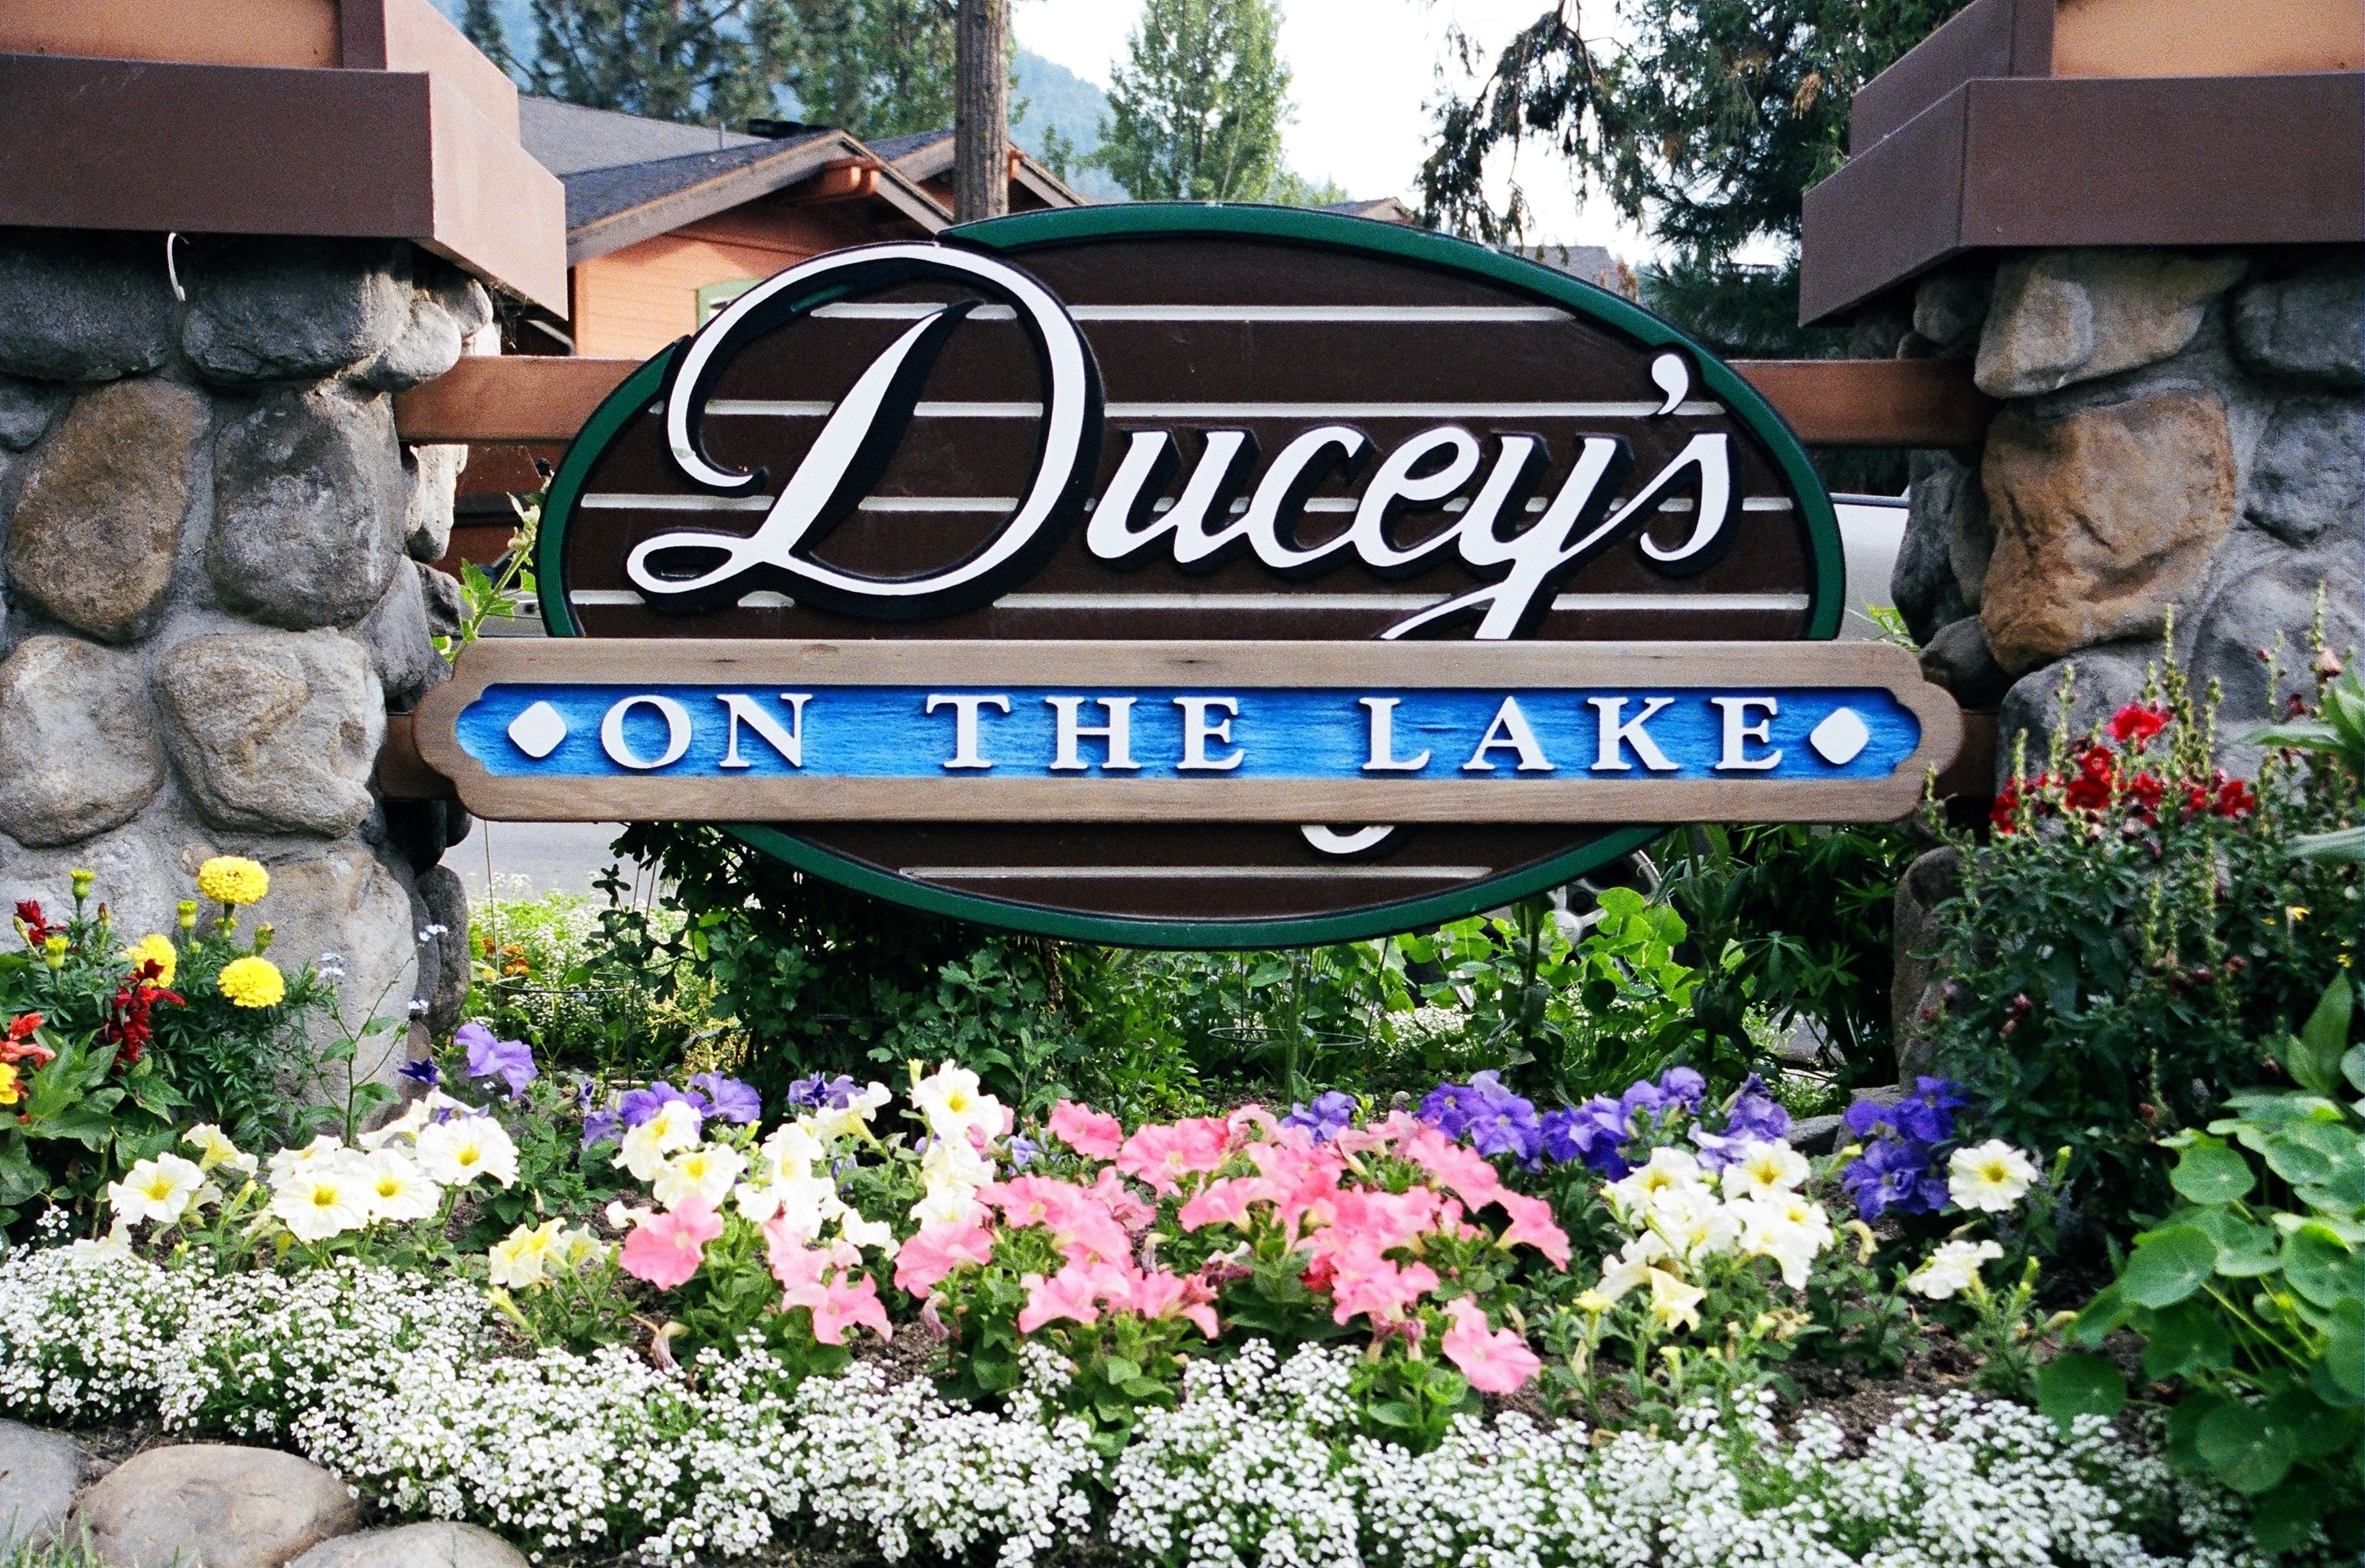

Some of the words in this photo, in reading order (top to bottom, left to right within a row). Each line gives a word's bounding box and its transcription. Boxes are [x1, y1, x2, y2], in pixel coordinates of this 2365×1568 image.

[626, 242, 1730, 854] Ducey's
[600, 694, 812, 769] ON
[926, 693, 1245, 770] THE
[1358, 695, 1783, 771] LAKE
